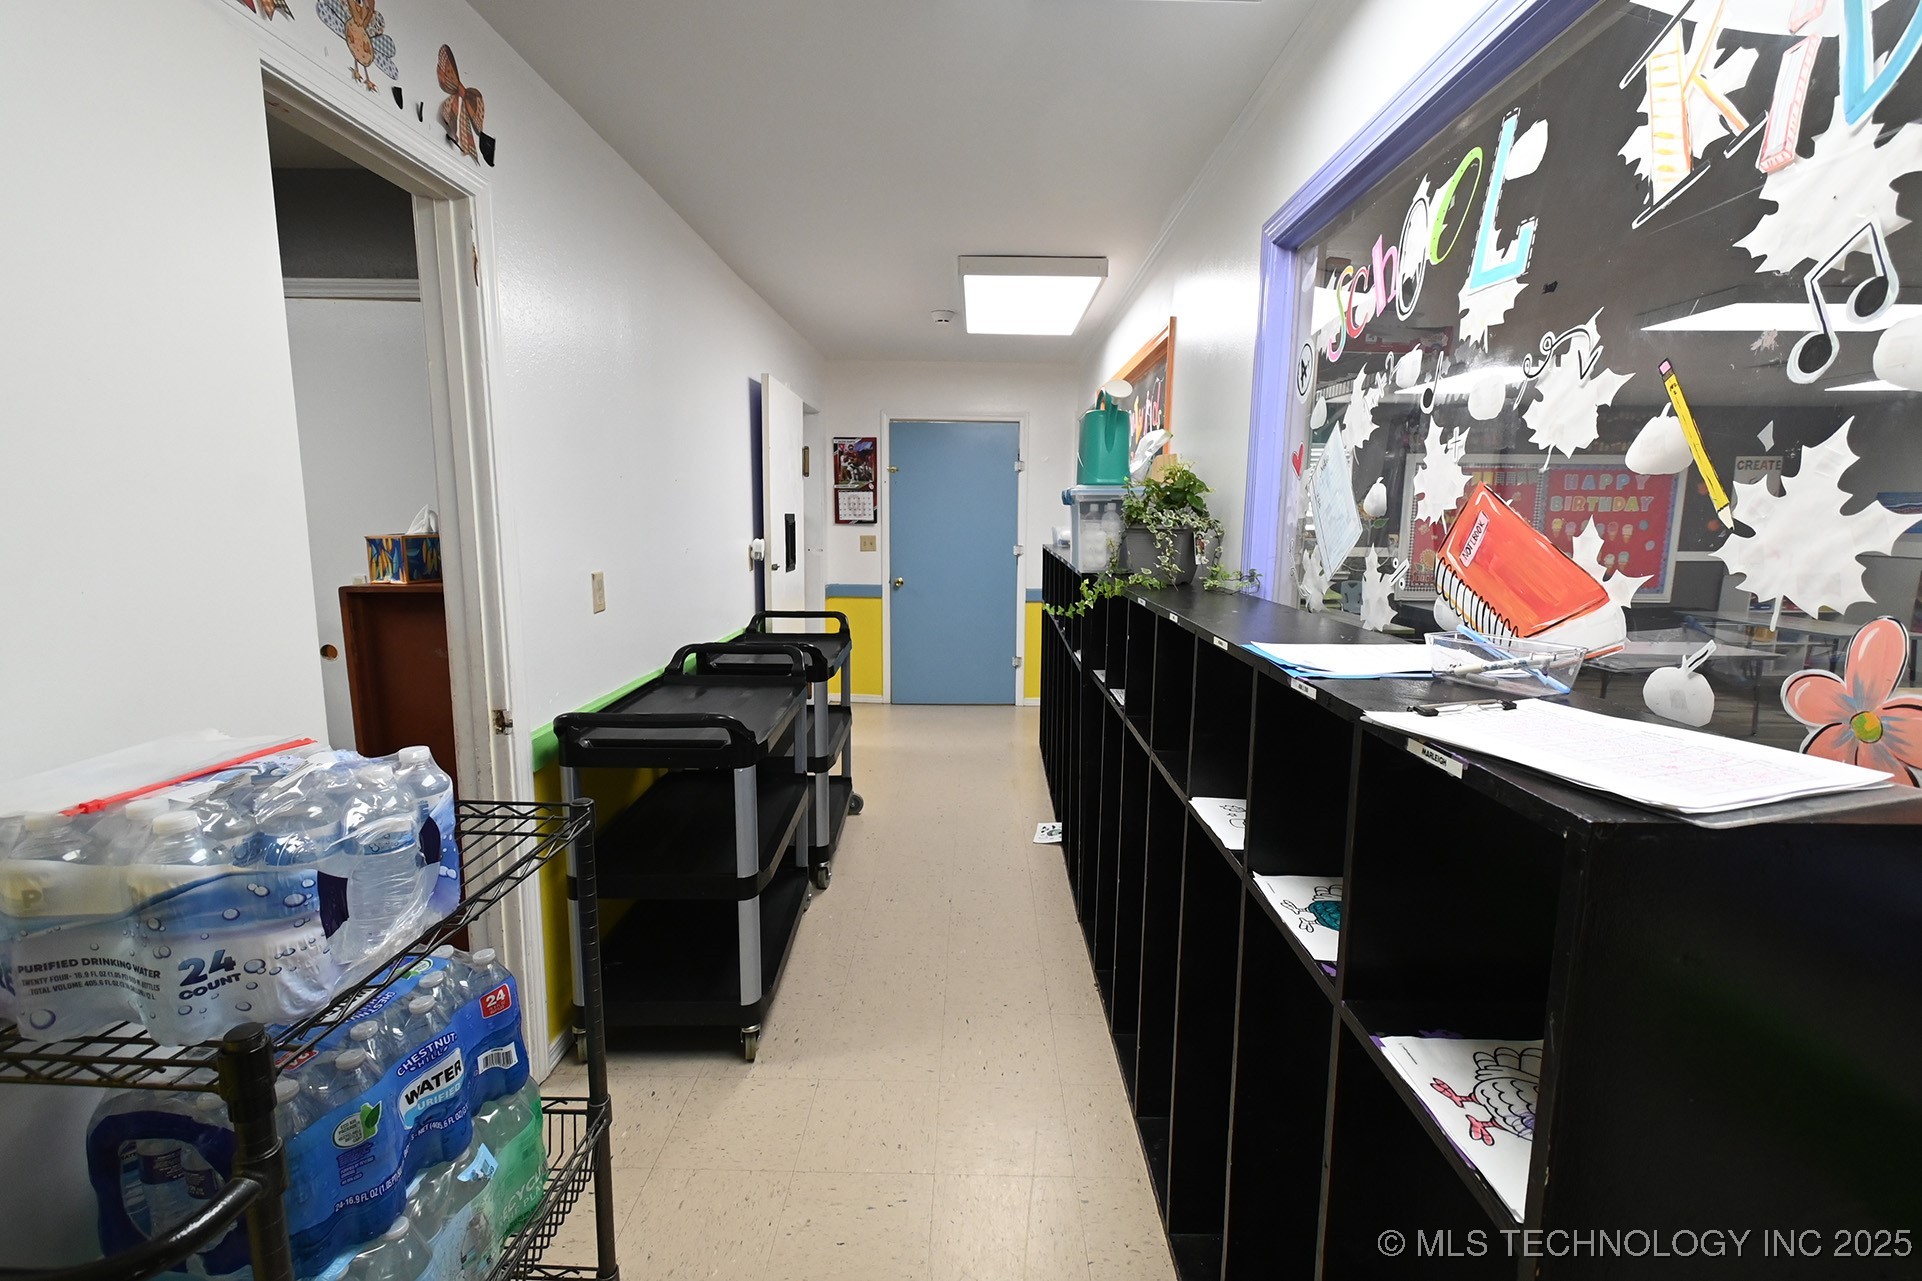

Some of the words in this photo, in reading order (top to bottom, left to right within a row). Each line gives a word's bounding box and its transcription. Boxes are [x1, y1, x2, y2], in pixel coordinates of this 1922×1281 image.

[1736, 460, 1782, 471] CREATE
[1564, 474, 1651, 490] HAPPY
[1550, 496, 1655, 512] BIRTHDAY
[1421, 747, 1447, 767] MARLEIGH
[18, 958, 79, 974] PURIFIED
[81, 957, 132, 971] DRINKING
[132, 963, 161, 979] WATER
[178, 949, 237, 987] 24
[22, 977, 48, 987] TWENTY
[30, 985, 51, 996] TOTAL
[54, 981, 83, 993] VOLUME
[178, 972, 242, 1000] COUNT
[486, 988, 506, 1008] 24
[396, 1032, 458, 1077] CHESTNUT
[404, 1059, 462, 1106] WATER
[417, 1082, 461, 1111] URIFIED
[360, 1192, 369, 1202] FL
